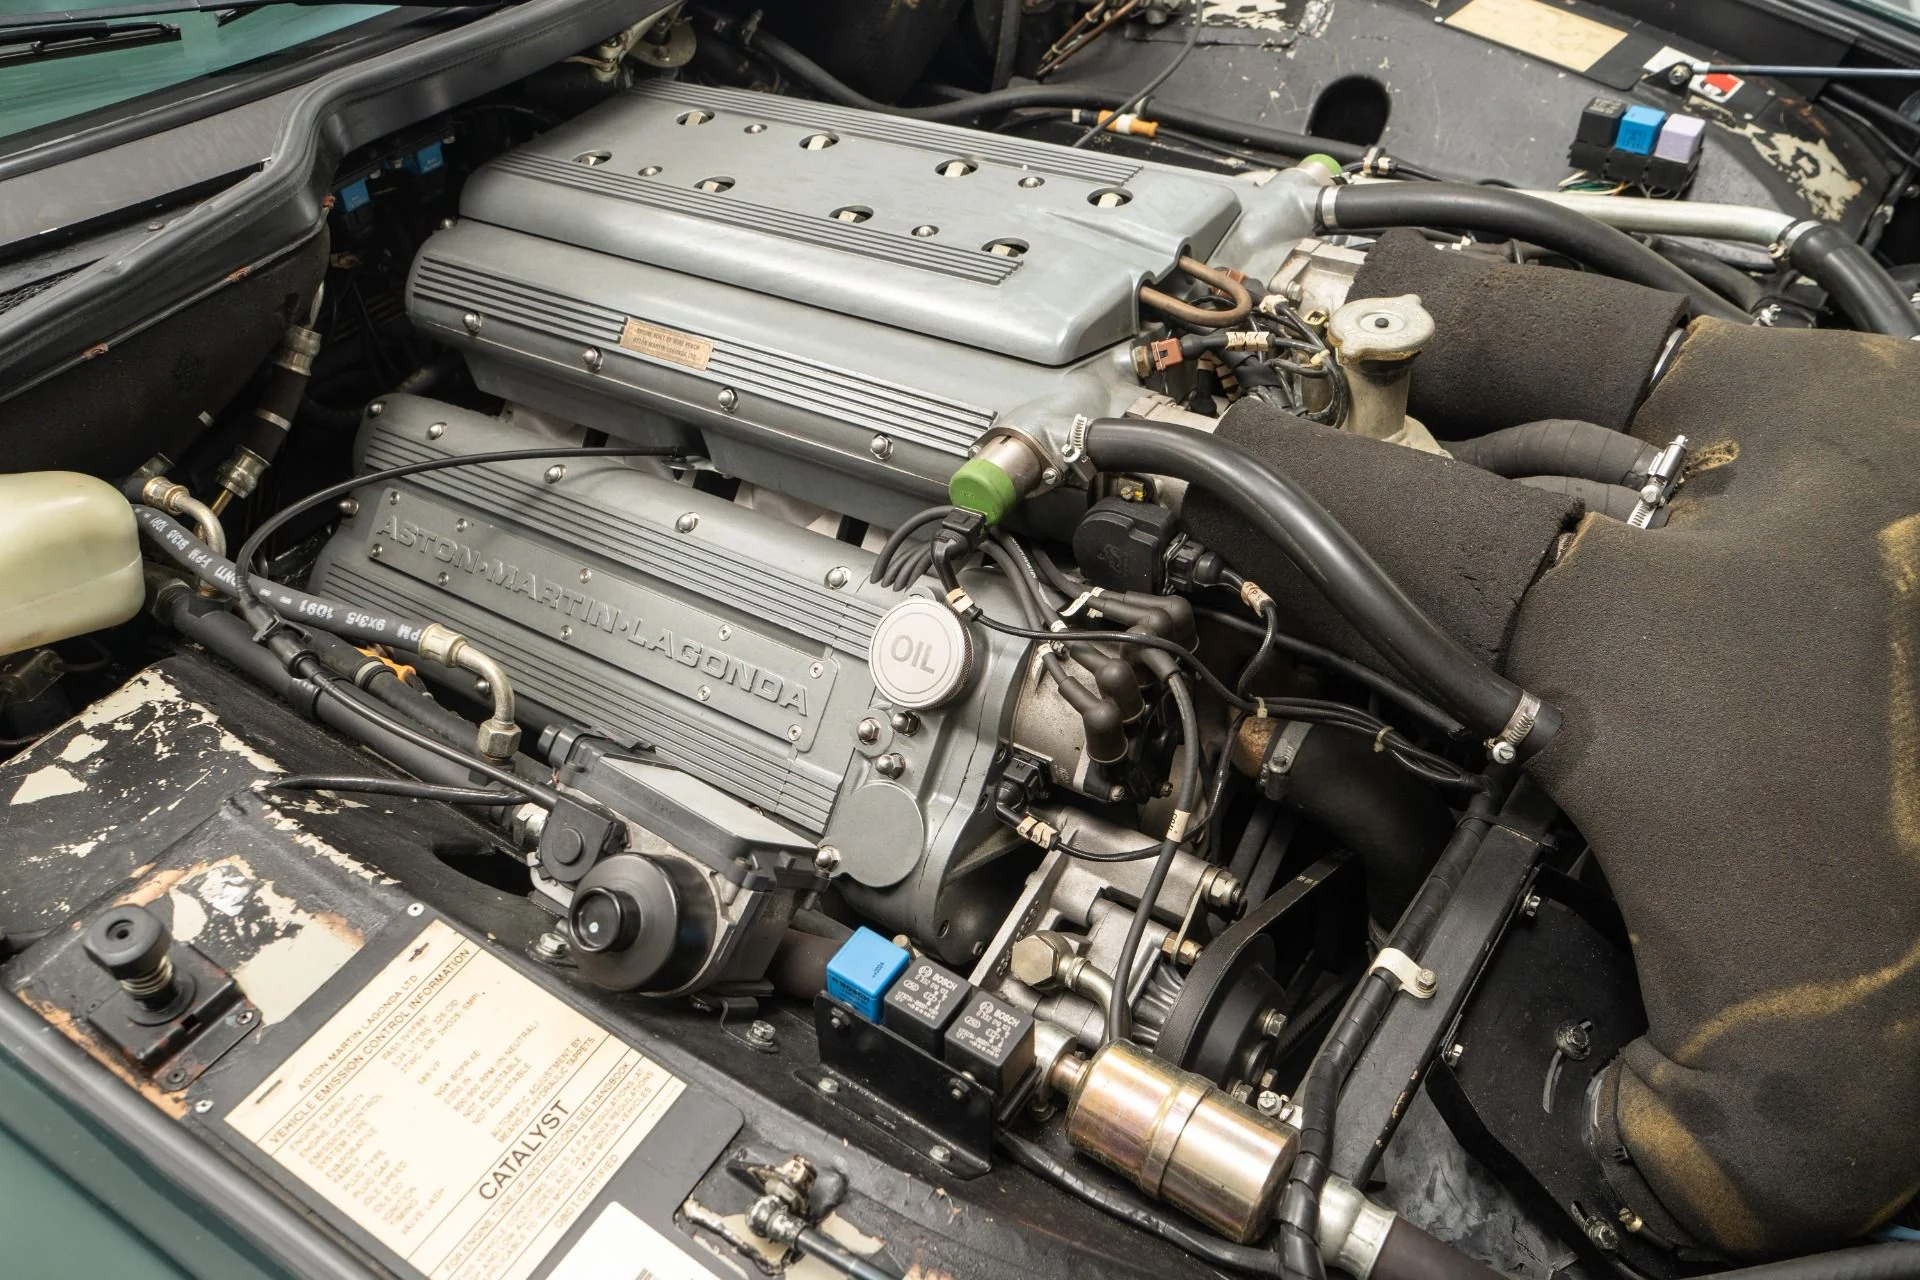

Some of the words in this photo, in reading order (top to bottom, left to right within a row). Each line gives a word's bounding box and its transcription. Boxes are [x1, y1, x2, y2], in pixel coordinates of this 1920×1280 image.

[214, 564, 237, 587] ONTI
[396, 623, 421, 642] PM
[891, 634, 935, 674] OIL
[932, 972, 958, 991] BOSCH
[297, 1062, 327, 1090] ASTON
[328, 1030, 361, 1060] MARTIN
[361, 991, 401, 1028] LAGONDA
[401, 975, 417, 989] LTD
[994, 1009, 1020, 1027] BOSCH
[270, 1101, 315, 1143] VEHICLE
[314, 1054, 363, 1100] EMISSION
[362, 1011, 409, 1054] CONTROL
[408, 949, 469, 1008] INFORMATION
[462, 1219, 492, 1251] ENGINE
[575, 1106, 591, 1121] SEE
[591, 1062, 630, 1105] HANDBOOK
[479, 1099, 570, 1201] CATALYST
[577, 1154, 618, 1201] CERTIFIED
